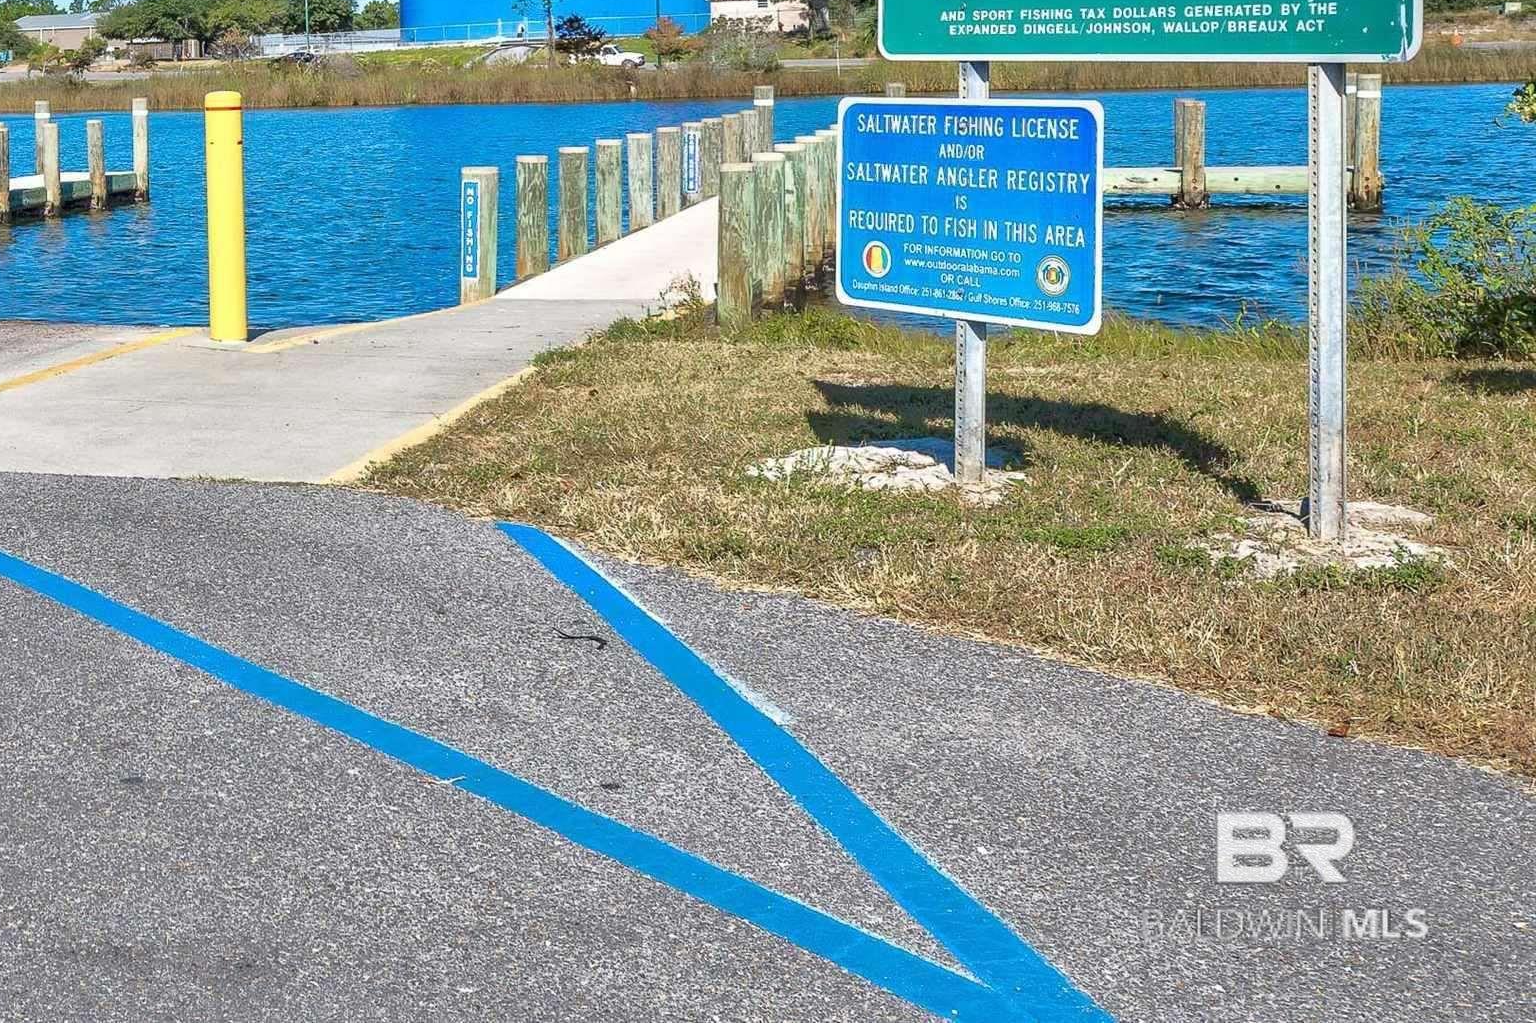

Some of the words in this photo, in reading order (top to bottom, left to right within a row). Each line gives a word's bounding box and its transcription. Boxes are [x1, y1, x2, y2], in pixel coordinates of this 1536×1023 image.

[940, 10, 965, 21] AND
[972, 9, 1013, 21] SPORT
[1020, 8, 1073, 20] FISHING
[1080, 8, 1105, 19] TAX
[1113, 6, 1176, 18] DOLLARS
[1184, 4, 1272, 18] GENERATED
[1281, 3, 1300, 16] BY
[1309, 2, 1337, 15] THE
[949, 24, 1016, 35] EXPANDED
[1164, 20, 1287, 33] WALLOP/BREAUX
[1296, 20, 1325, 32] ACT
[857, 113, 936, 135] SALTWATER
[944, 115, 1003, 137] FISHING
[1012, 117, 1079, 139] LICENSE
[939, 143, 984, 160] AND/OR
[847, 162, 928, 185] SALTWATER
[936, 166, 998, 188] ANGLER
[1007, 169, 1090, 194] REGISTRY
[955, 195, 967, 210] IS
[849, 209, 914, 233] REQUIRED
[922, 215, 938, 235] TO
[945, 217, 976, 238] FISH
[984, 220, 997, 240] IN
[1005, 222, 1037, 244] THIS
[1045, 225, 1085, 247] AREA
[904, 243, 923, 253] FOR
[925, 244, 987, 260] INFORMATION
[991, 252, 1005, 262] GO
[1008, 252, 1021, 263] TO
[904, 258, 1020, 277] www.outdooralabama.com
[941, 273, 954, 284] OR
[957, 275, 981, 288] CALL
